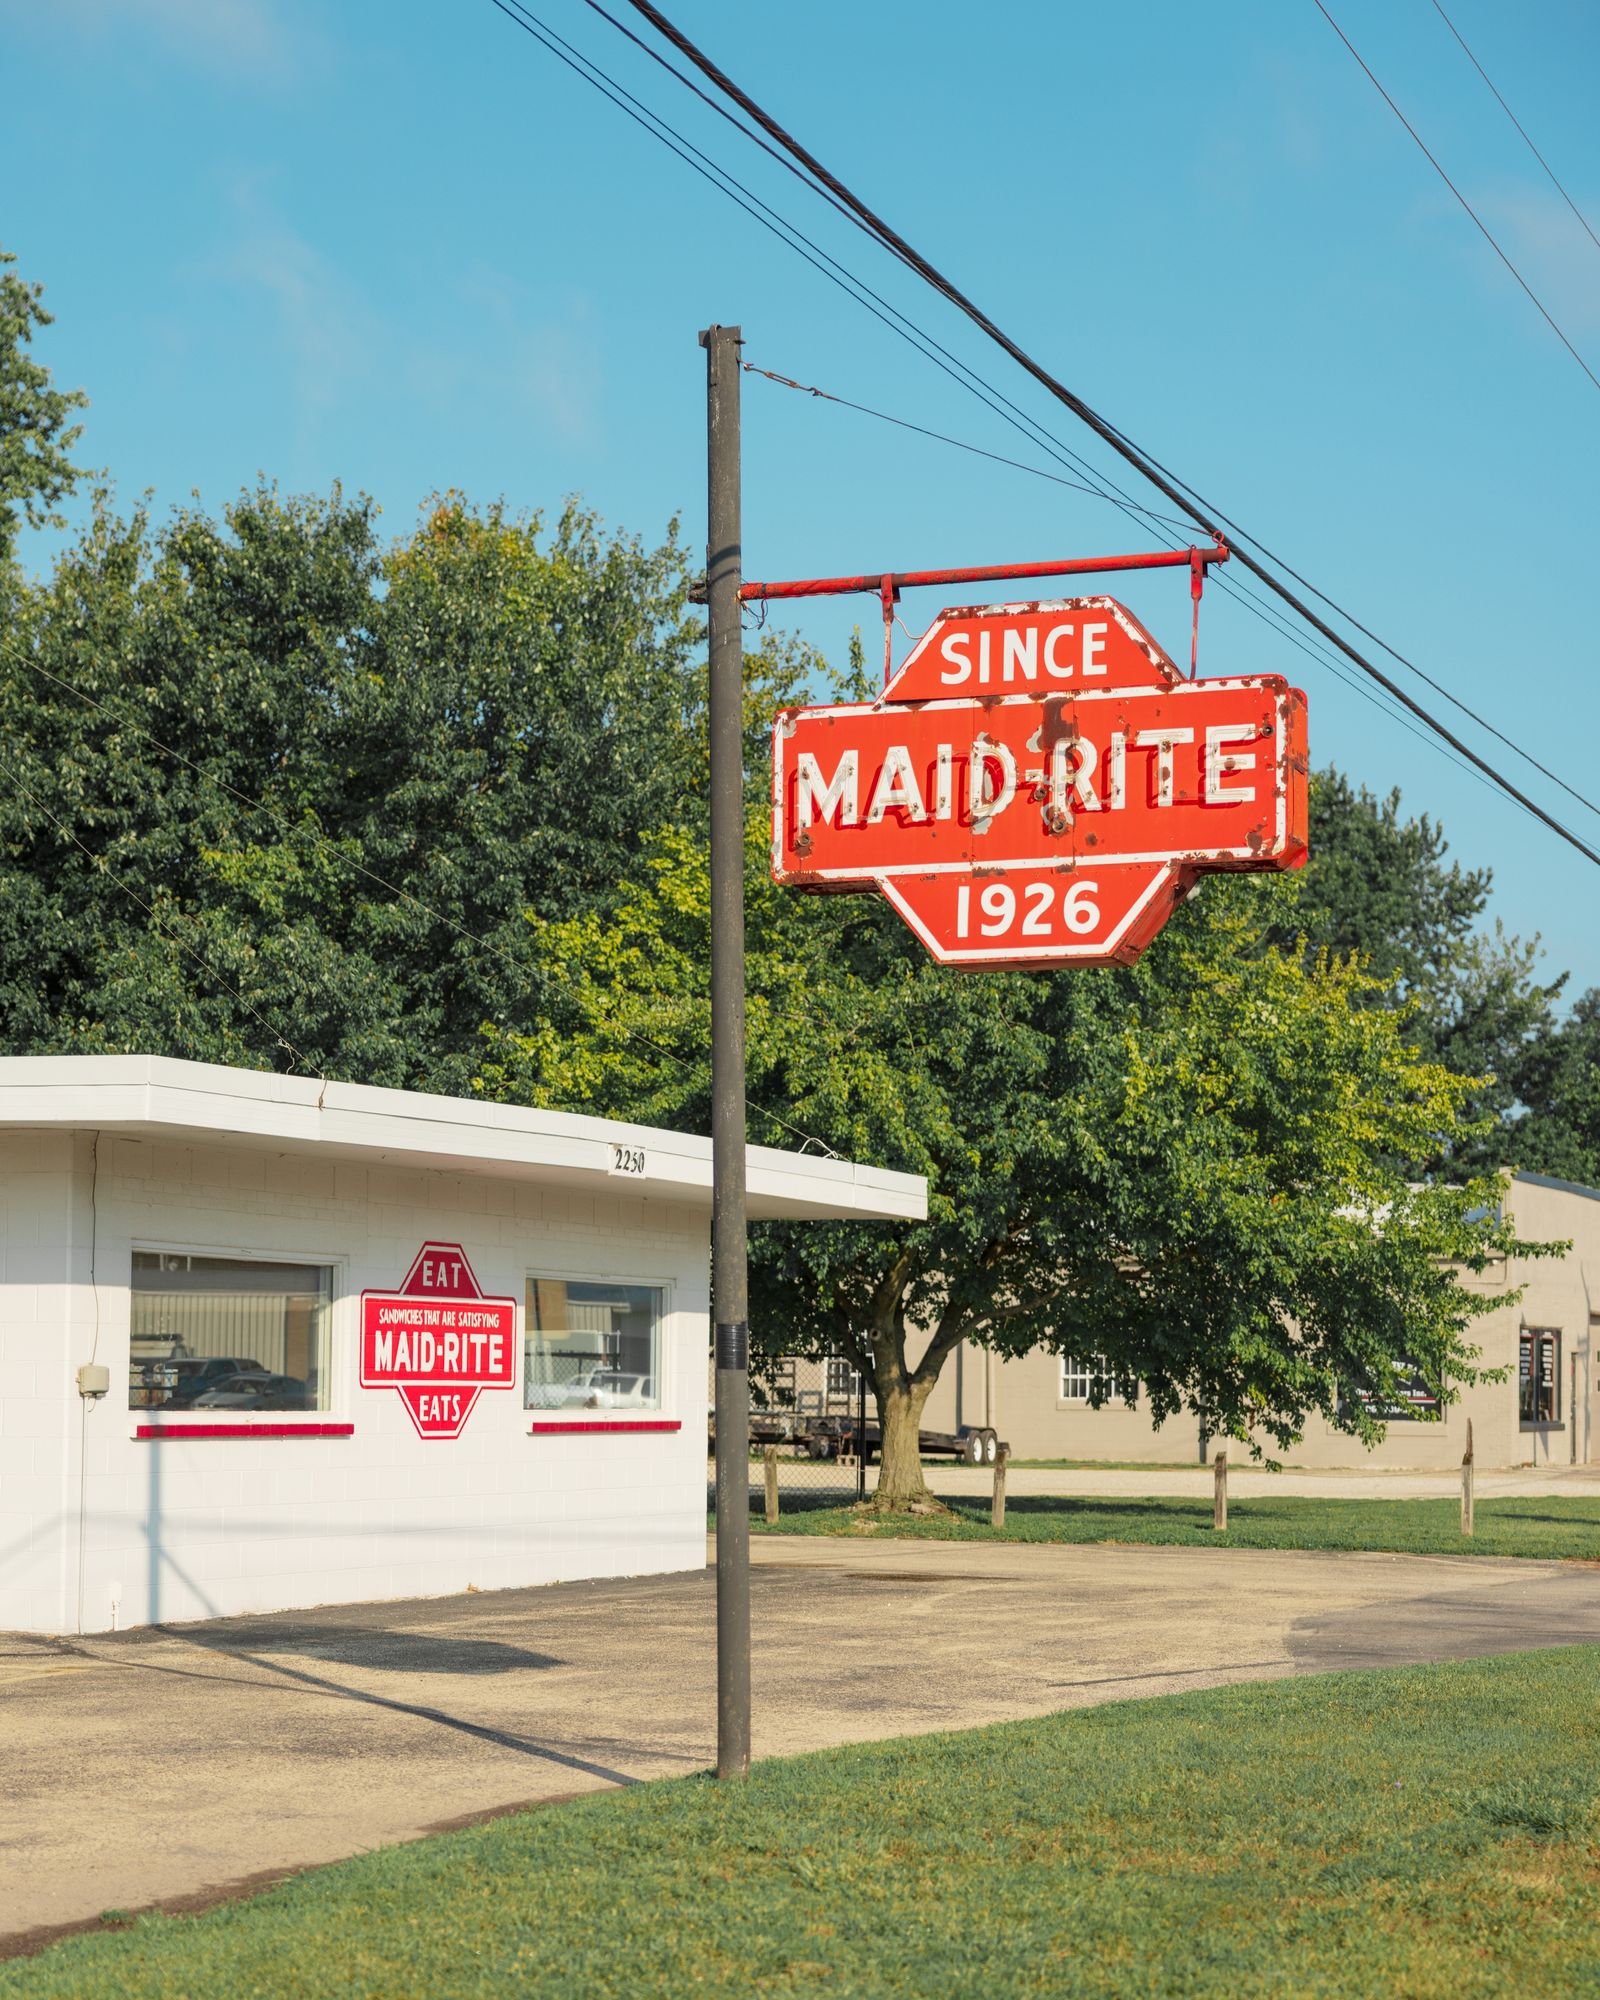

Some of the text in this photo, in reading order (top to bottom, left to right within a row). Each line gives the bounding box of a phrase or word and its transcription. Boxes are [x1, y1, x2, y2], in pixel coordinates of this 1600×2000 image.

[941, 622, 1108, 685] SINCE
[797, 723, 1256, 829] MAID-RITE
[956, 881, 1101, 938] 1926
[615, 1148, 645, 1173] 2250
[422, 1261, 462, 1288] EAT
[379, 1308, 499, 1328] SANDWICHES THAT ARE SATISFYING
[419, 1394, 460, 1421] EATS
